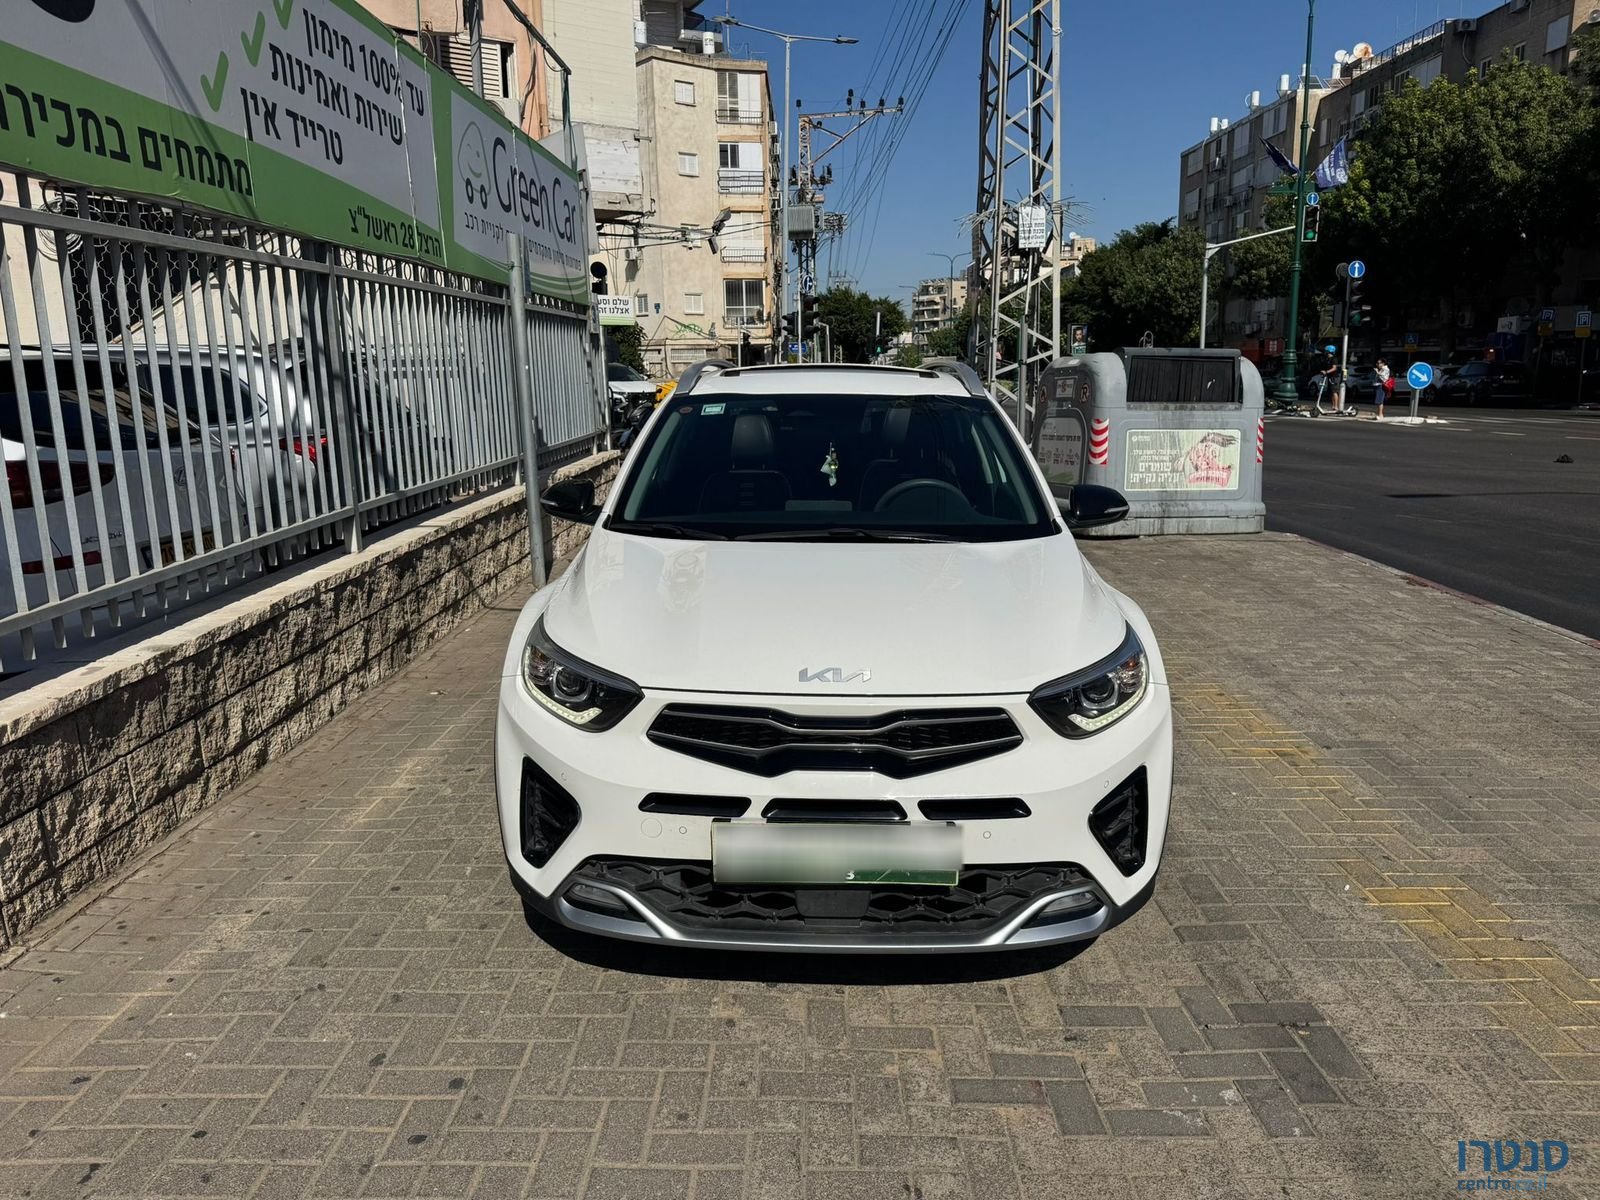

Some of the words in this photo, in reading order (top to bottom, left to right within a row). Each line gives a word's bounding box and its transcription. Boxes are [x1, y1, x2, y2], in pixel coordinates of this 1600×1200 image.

[302, 8, 355, 73] מימון
[268, 42, 350, 119] ואמינות
[359, 44, 402, 100] 100%
[240, 87, 281, 141] אין
[406, 78, 425, 117] עד
[285, 108, 344, 166] טרייד
[353, 91, 403, 146] שירות
[137, 126, 253, 197] מתמחים
[493, 137, 552, 232] Green
[553, 177, 576, 245] Car
[400, 223, 416, 250] 28
[416, 222, 443, 258] הרצל
[464, 212, 479, 233] רכב
[481, 219, 504, 245] לקניית
[609, 306, 630, 315] אצלנו
[612, 297, 630, 306] שלם
[1139, 462, 1172, 472] שומרים
[799, 667, 872, 683] KIA
